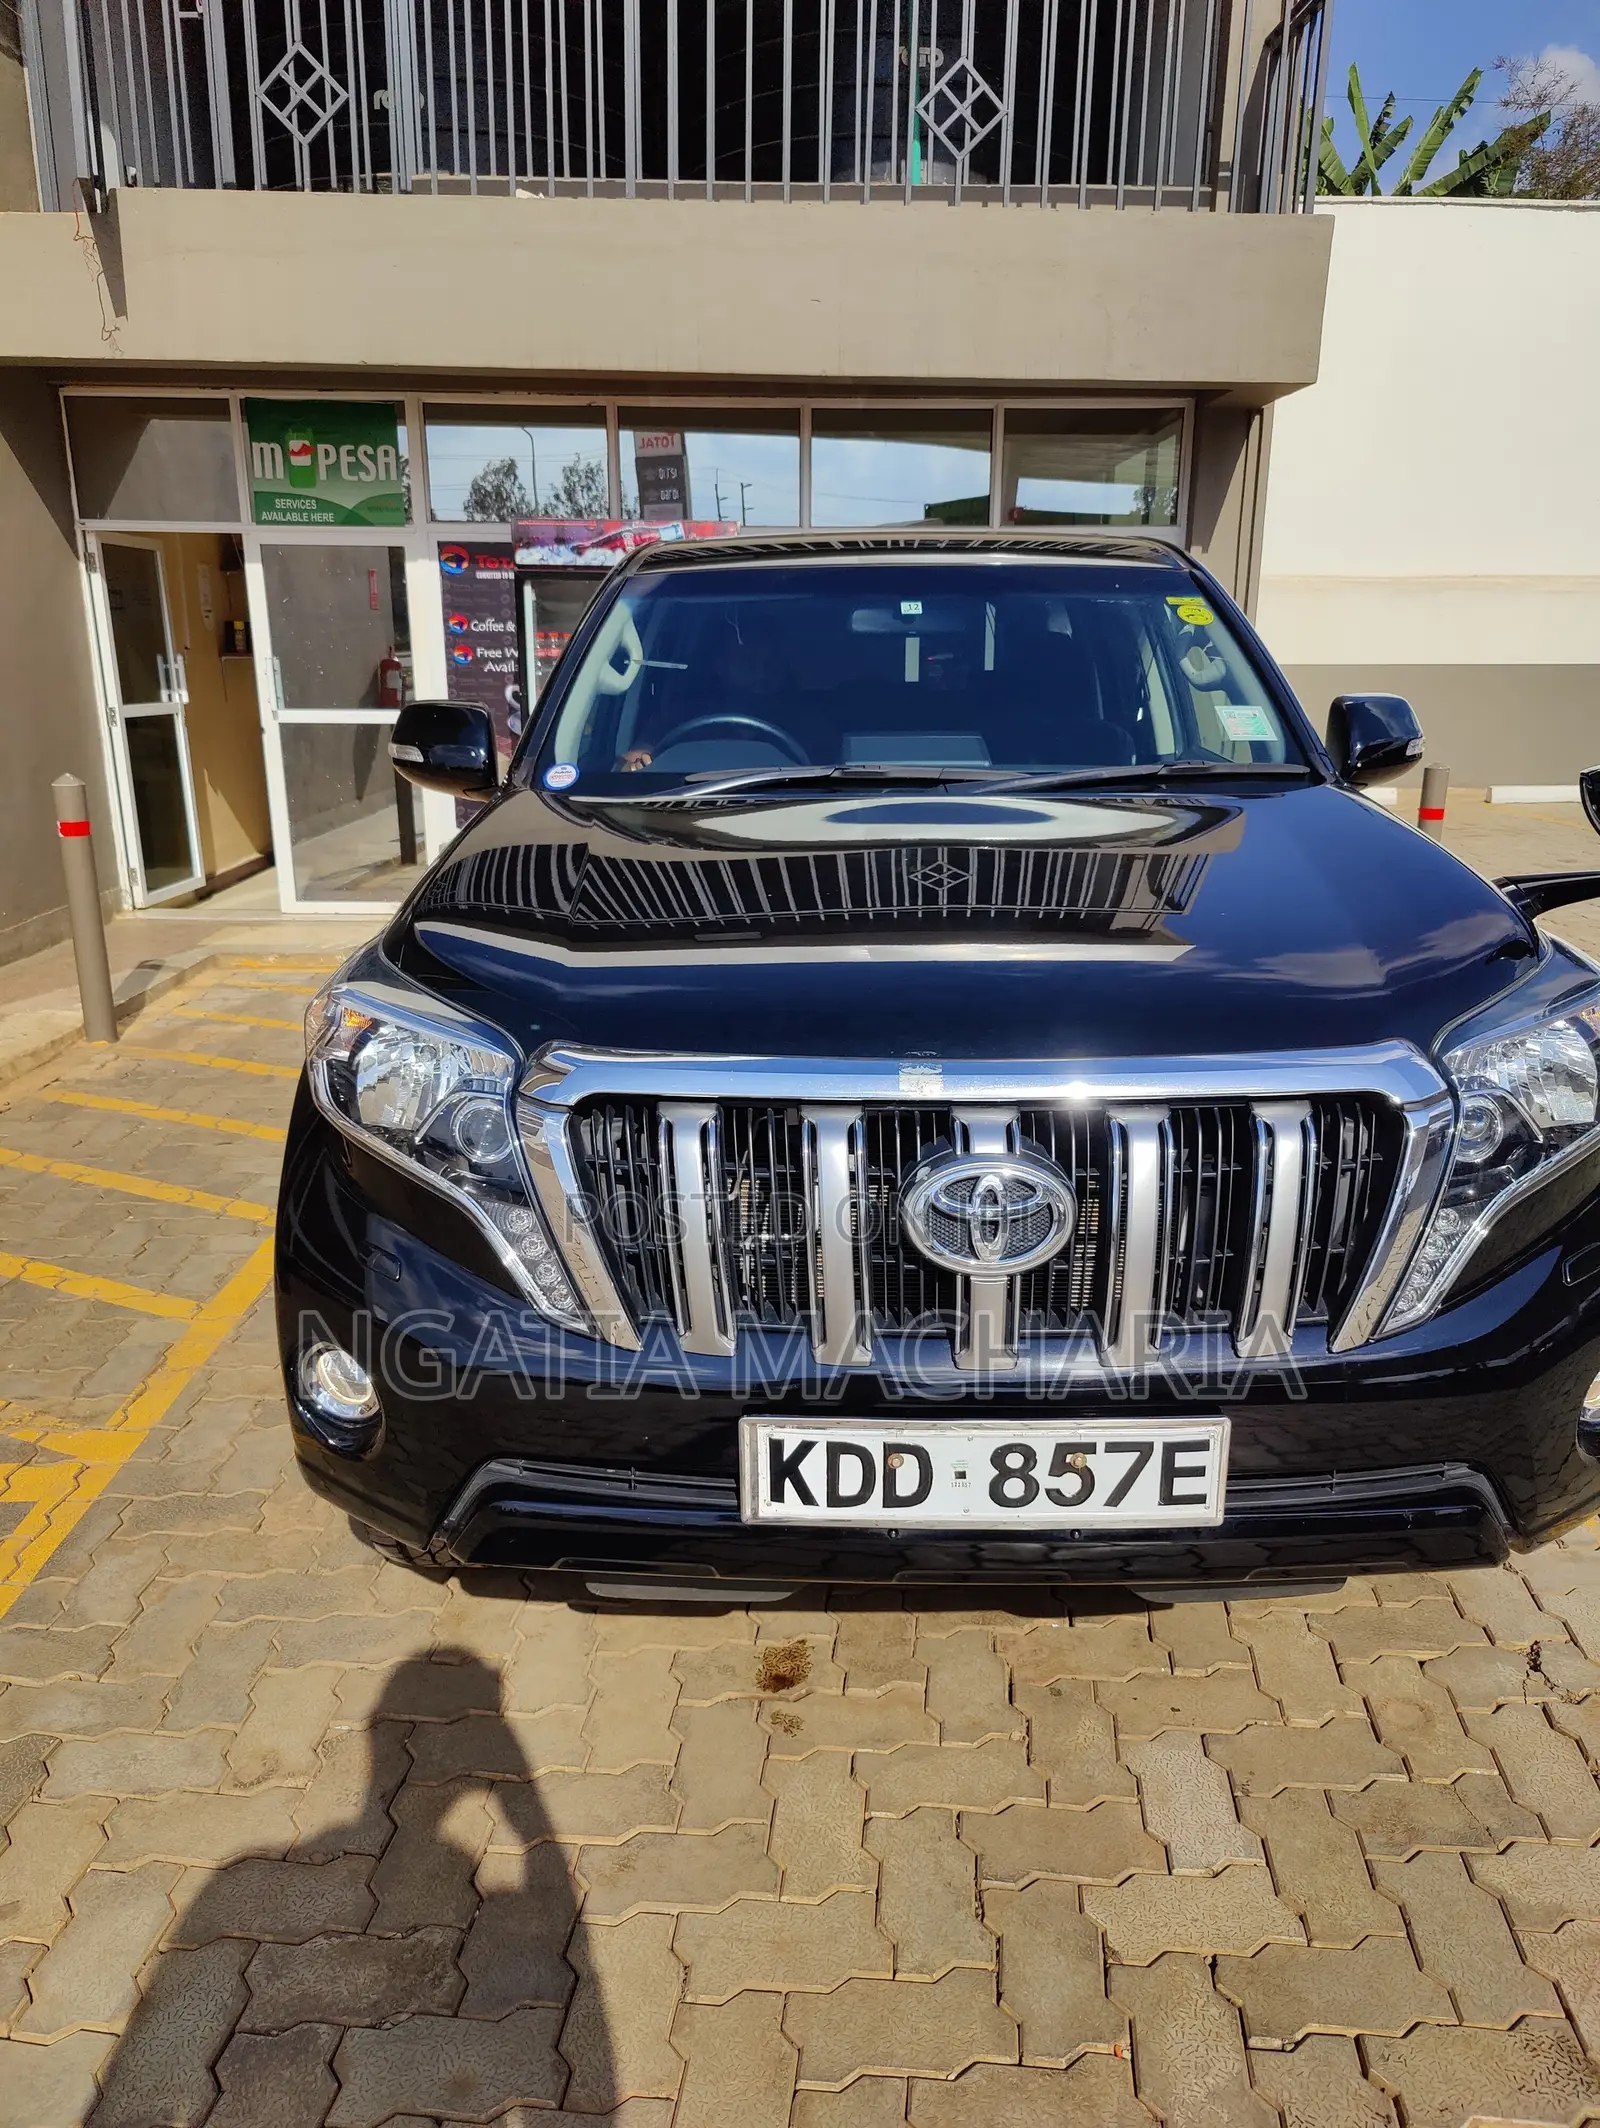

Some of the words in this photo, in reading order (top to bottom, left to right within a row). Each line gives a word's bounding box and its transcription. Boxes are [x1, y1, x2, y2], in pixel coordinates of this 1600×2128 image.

[316, 443, 398, 482] PESA
[275, 498, 317, 510] SERVICES
[261, 511, 309, 523] AVAILABLE
[310, 512, 335, 523] HERE
[471, 617, 505, 632] Coffee
[506, 620, 516, 633] &
[476, 646, 503, 658] Free
[768, 1437, 934, 1509] KDD
[988, 1438, 1212, 1509] 857E
